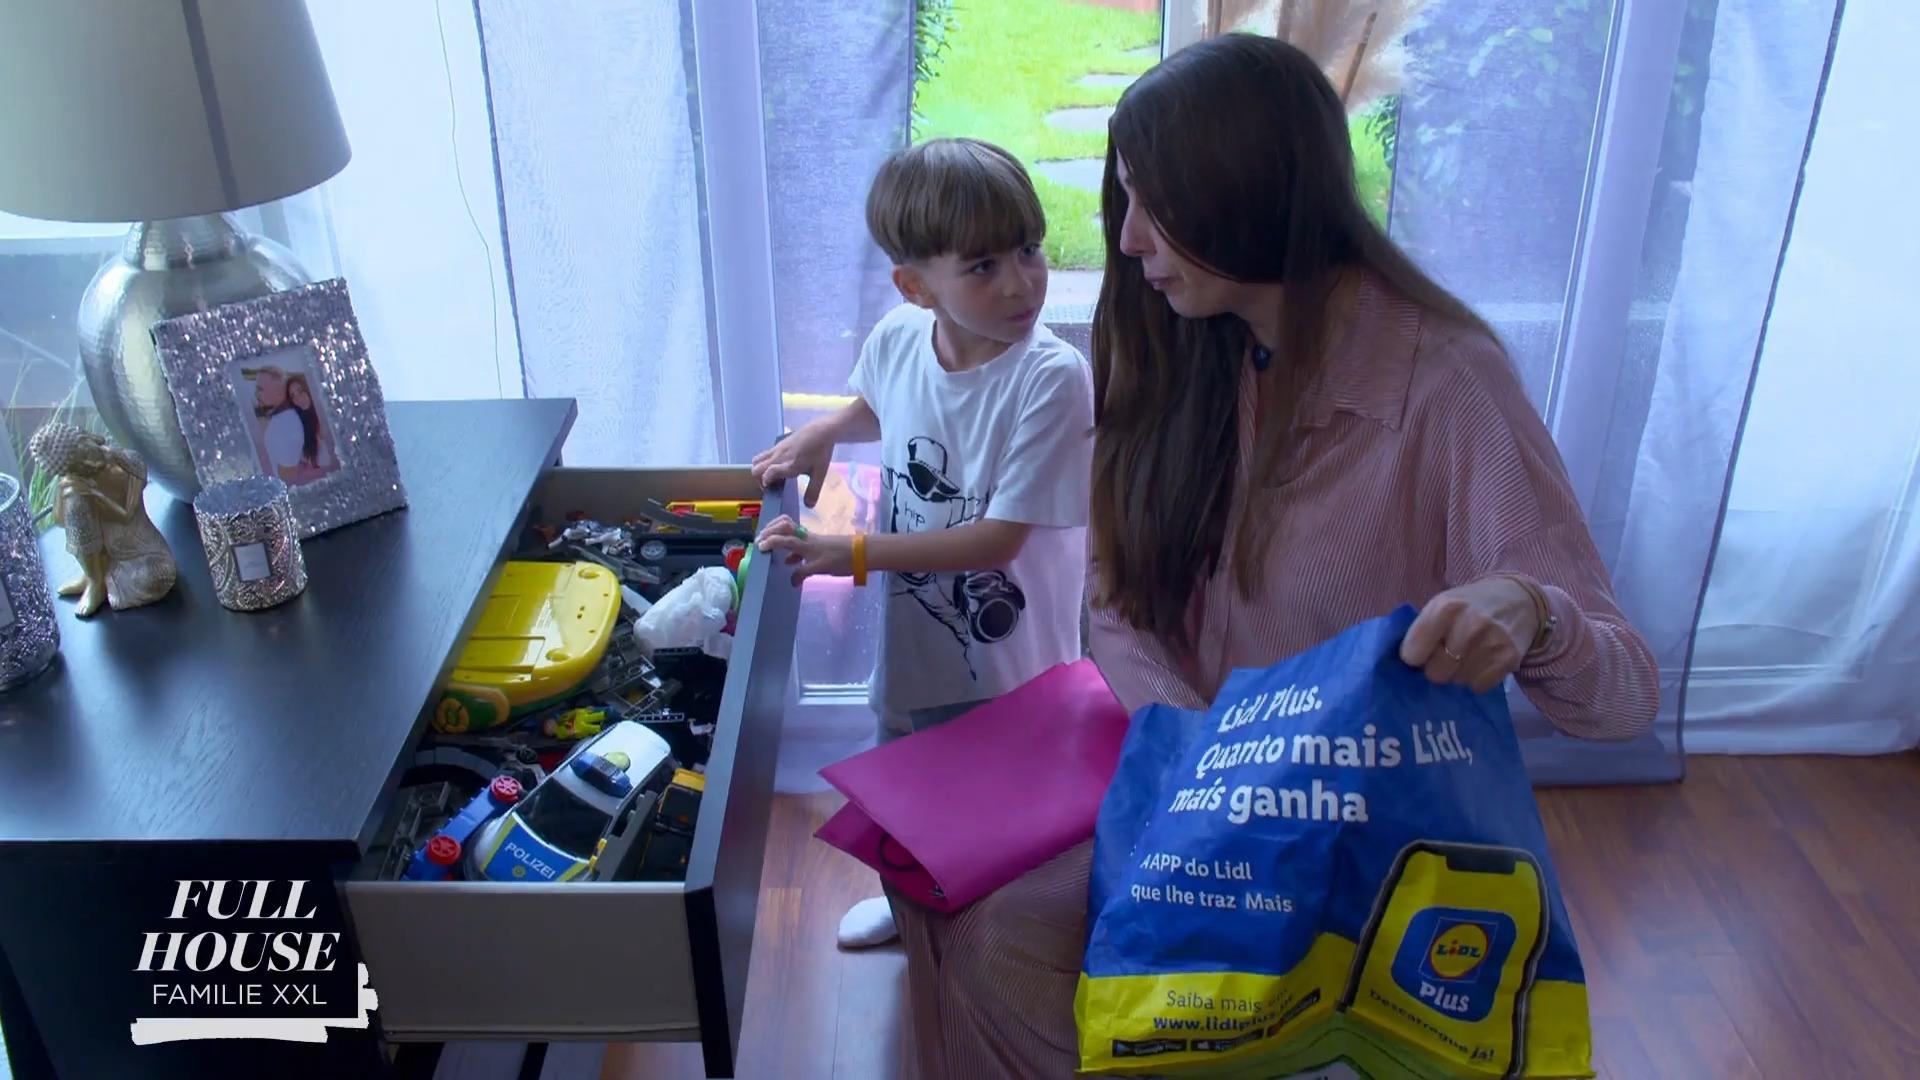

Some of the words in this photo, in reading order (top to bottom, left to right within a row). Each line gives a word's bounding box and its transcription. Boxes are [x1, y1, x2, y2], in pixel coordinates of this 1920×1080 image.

[1217, 692, 1266, 733] Lidl
[1262, 684, 1322, 721] Plus.
[1196, 734, 1285, 779] Quanto
[1291, 723, 1401, 768] mais
[1412, 719, 1473, 766] Lidl,
[1168, 777, 1227, 813] mais
[1227, 778, 1369, 825] ganha
[504, 842, 556, 880] POLIZEI
[1184, 858, 1209, 877] do
[1214, 860, 1253, 880] Lidl
[1131, 883, 1161, 903] que
[1166, 885, 1194, 905] lhe
[1200, 891, 1237, 909] traz
[1245, 893, 1293, 913] Mais
[1166, 990, 1214, 1010] Saiba
[1220, 997, 1262, 1013] mais
[1419, 981, 1470, 1012] Plus
